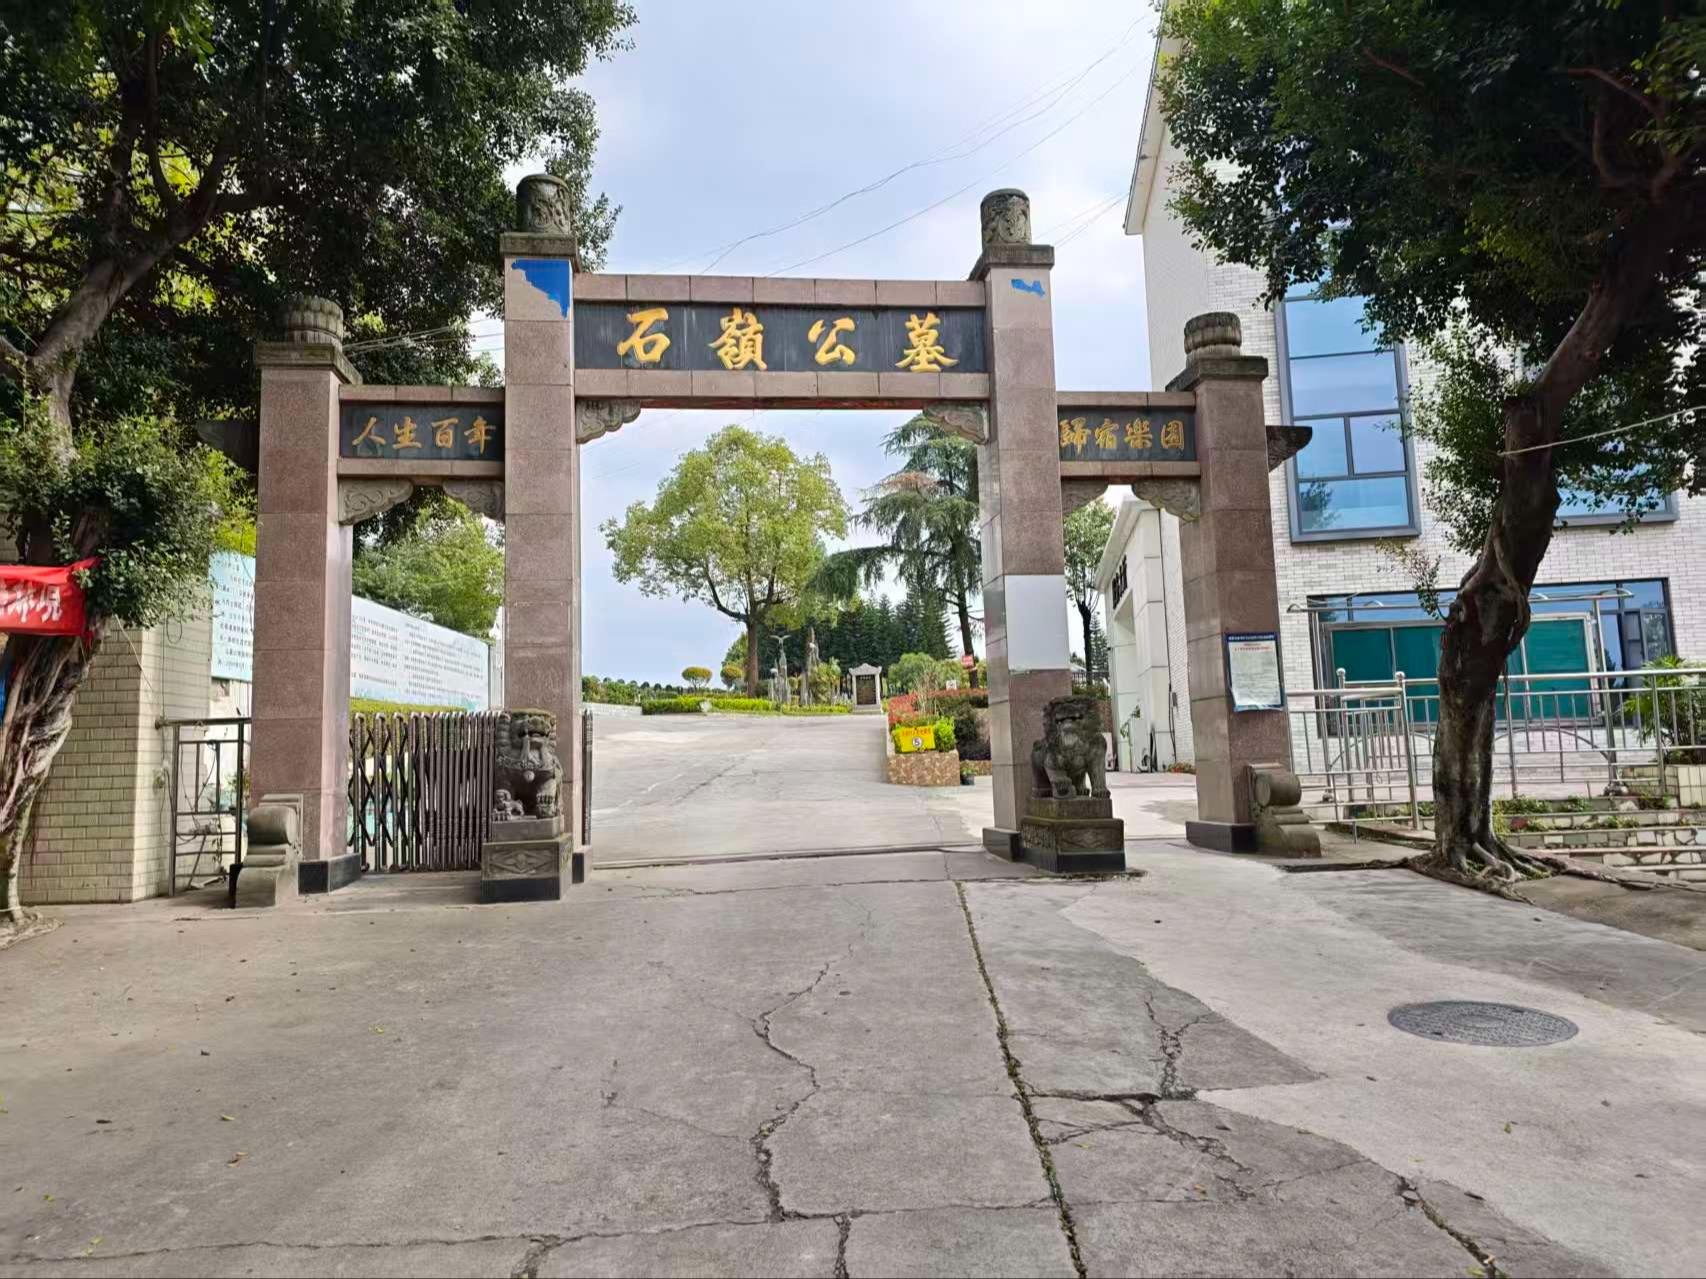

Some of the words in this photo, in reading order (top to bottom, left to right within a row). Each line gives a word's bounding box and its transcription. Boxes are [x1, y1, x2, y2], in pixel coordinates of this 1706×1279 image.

[616, 306, 958, 373] 石嶺公墓
[352, 416, 496, 454] 人生百年
